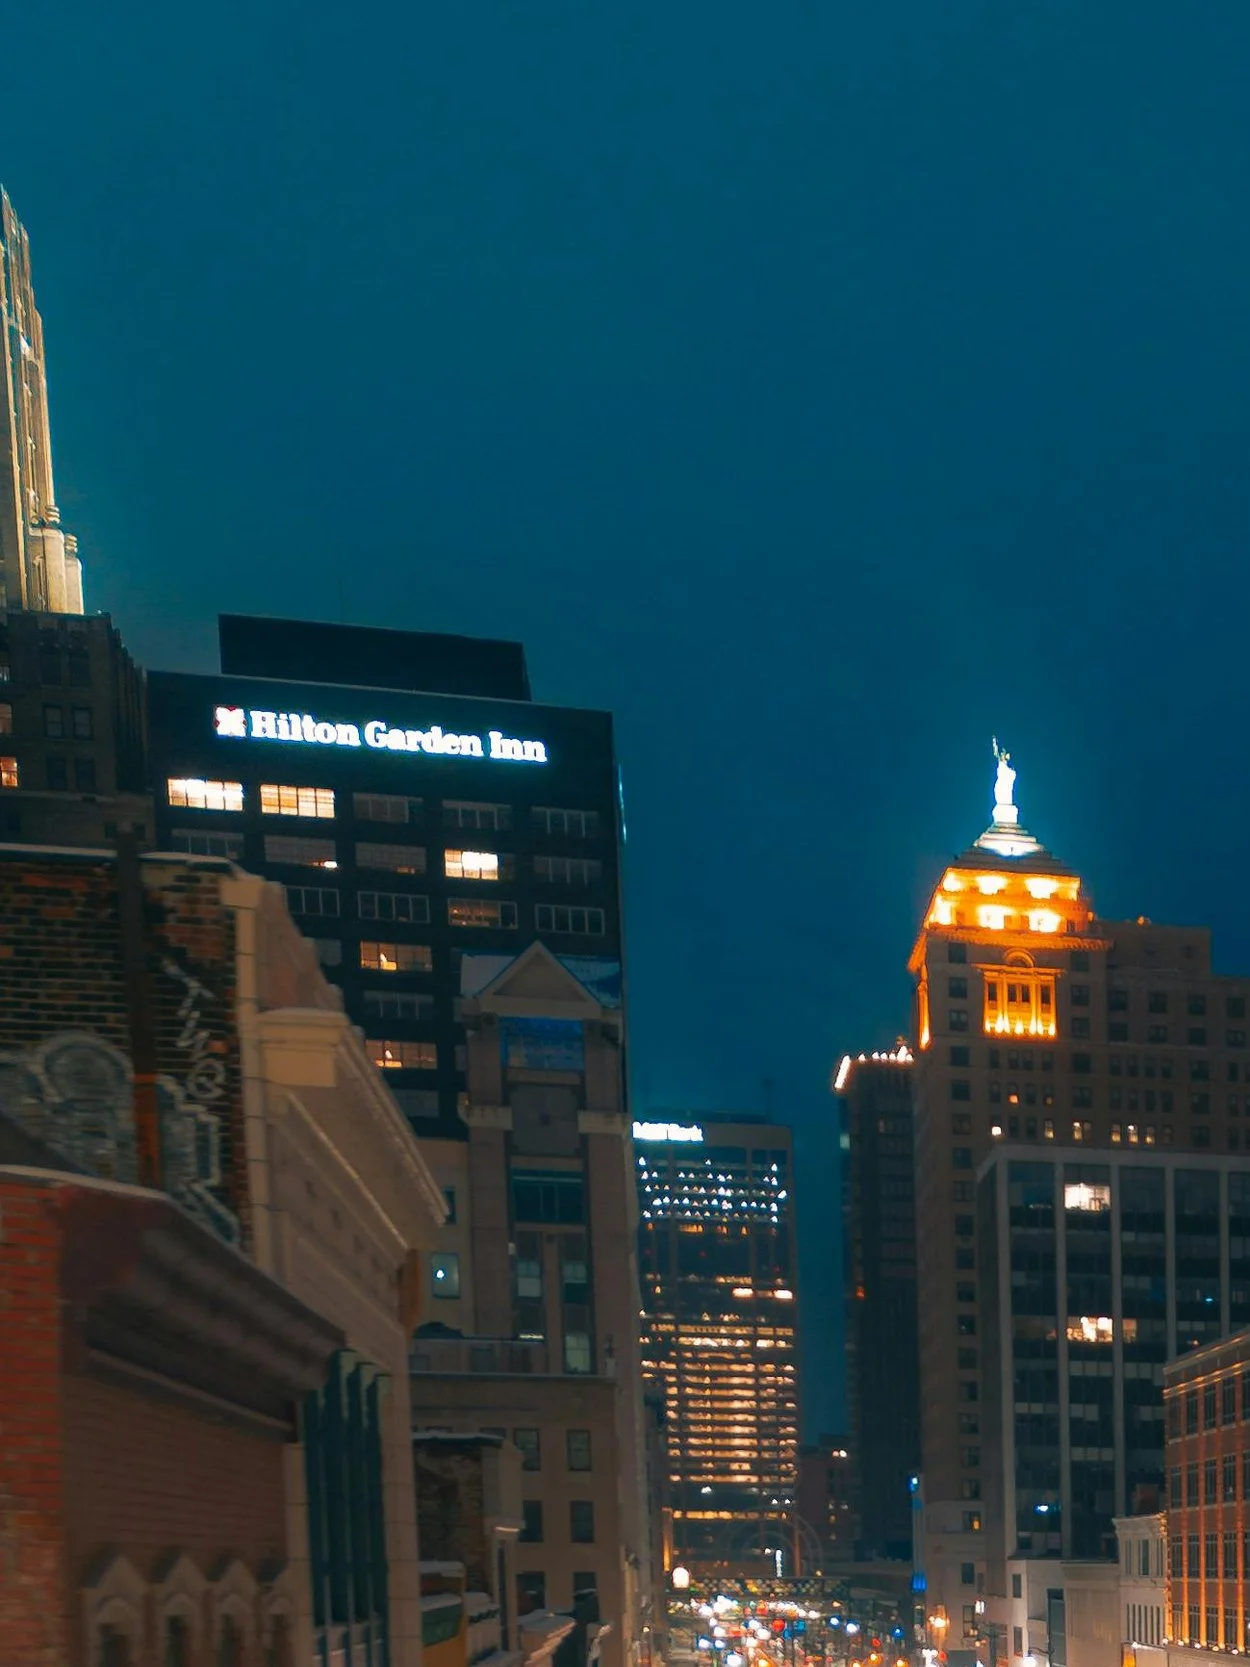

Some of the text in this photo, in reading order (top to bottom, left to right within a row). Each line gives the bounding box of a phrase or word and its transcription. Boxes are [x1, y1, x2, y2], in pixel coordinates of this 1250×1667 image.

[250, 711, 547, 762] Hilton Garden Inn
